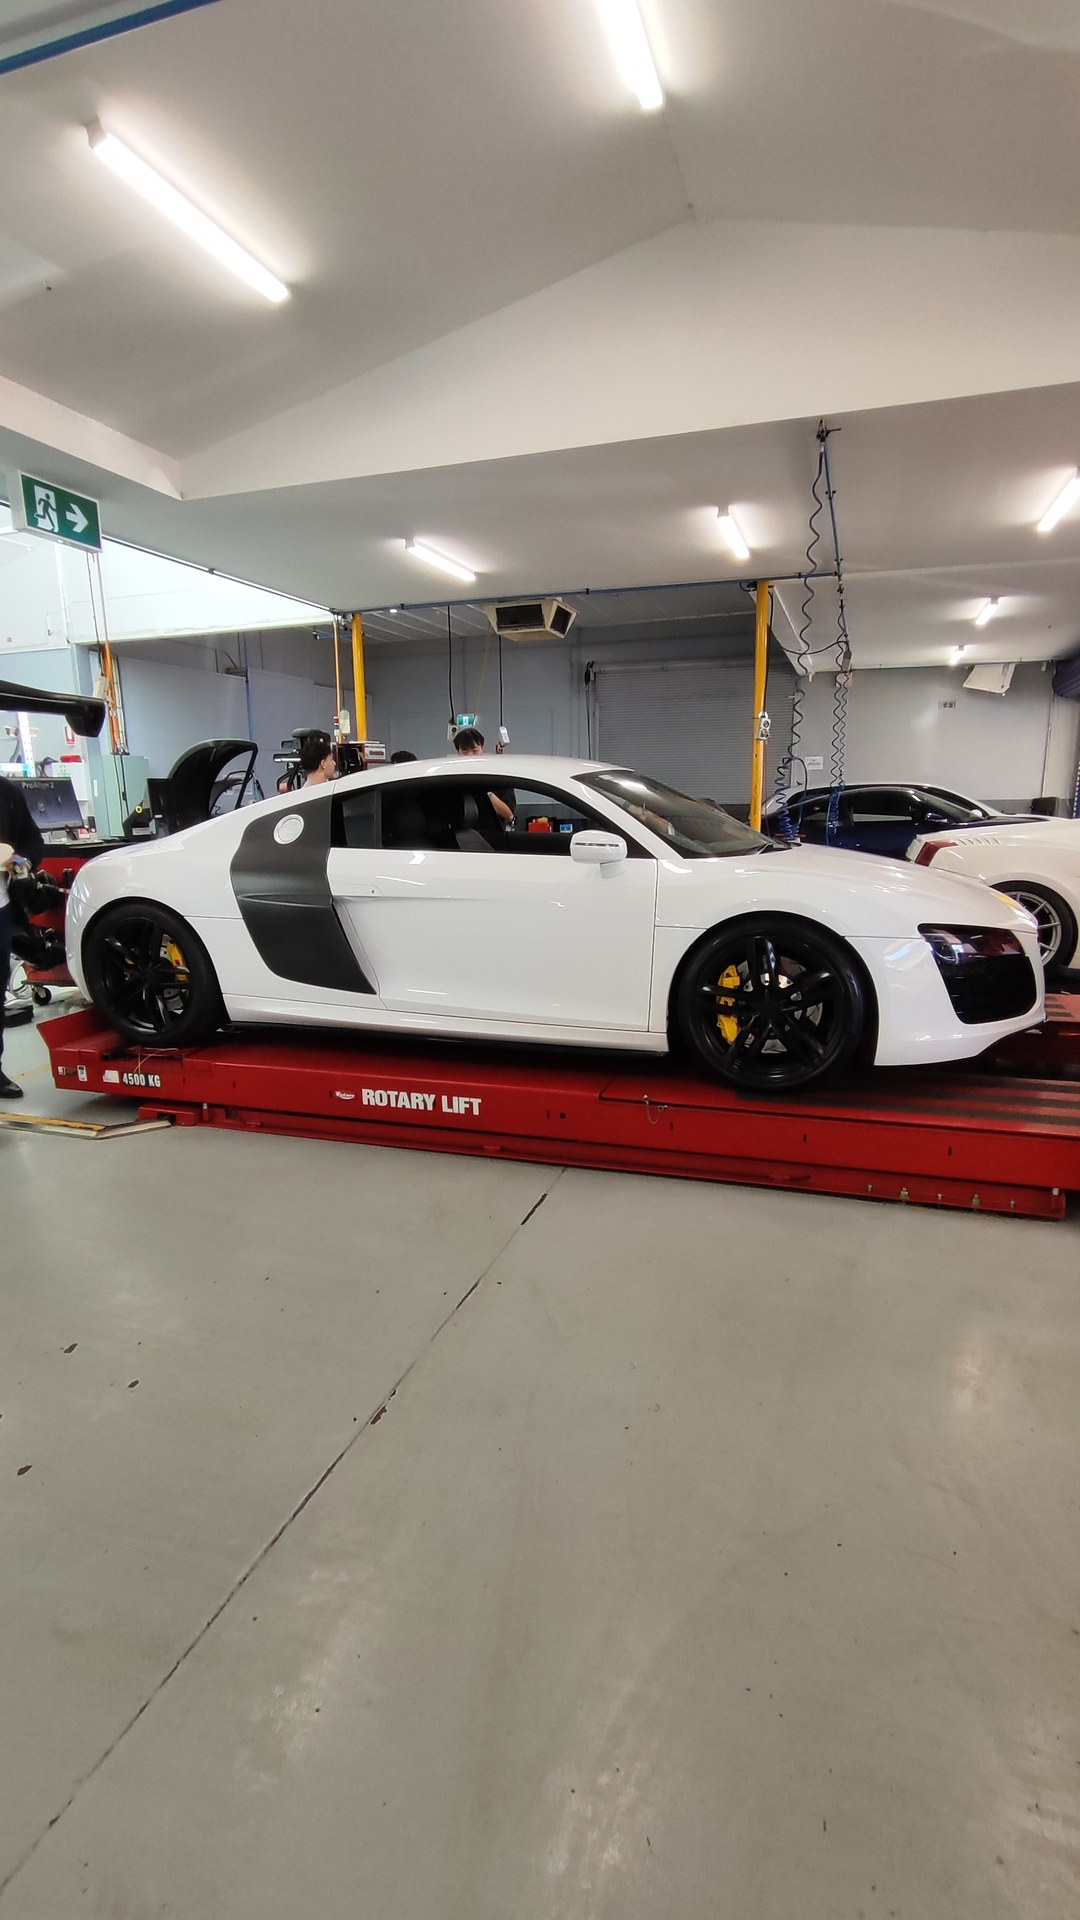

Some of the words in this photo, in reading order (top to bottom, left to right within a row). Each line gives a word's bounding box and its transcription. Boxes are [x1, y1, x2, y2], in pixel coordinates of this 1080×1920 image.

[122, 1072, 145, 1086] 4500
[148, 1074, 161, 1088] KG
[361, 1088, 436, 1111] ROTARY
[441, 1095, 482, 1116] LIFT
